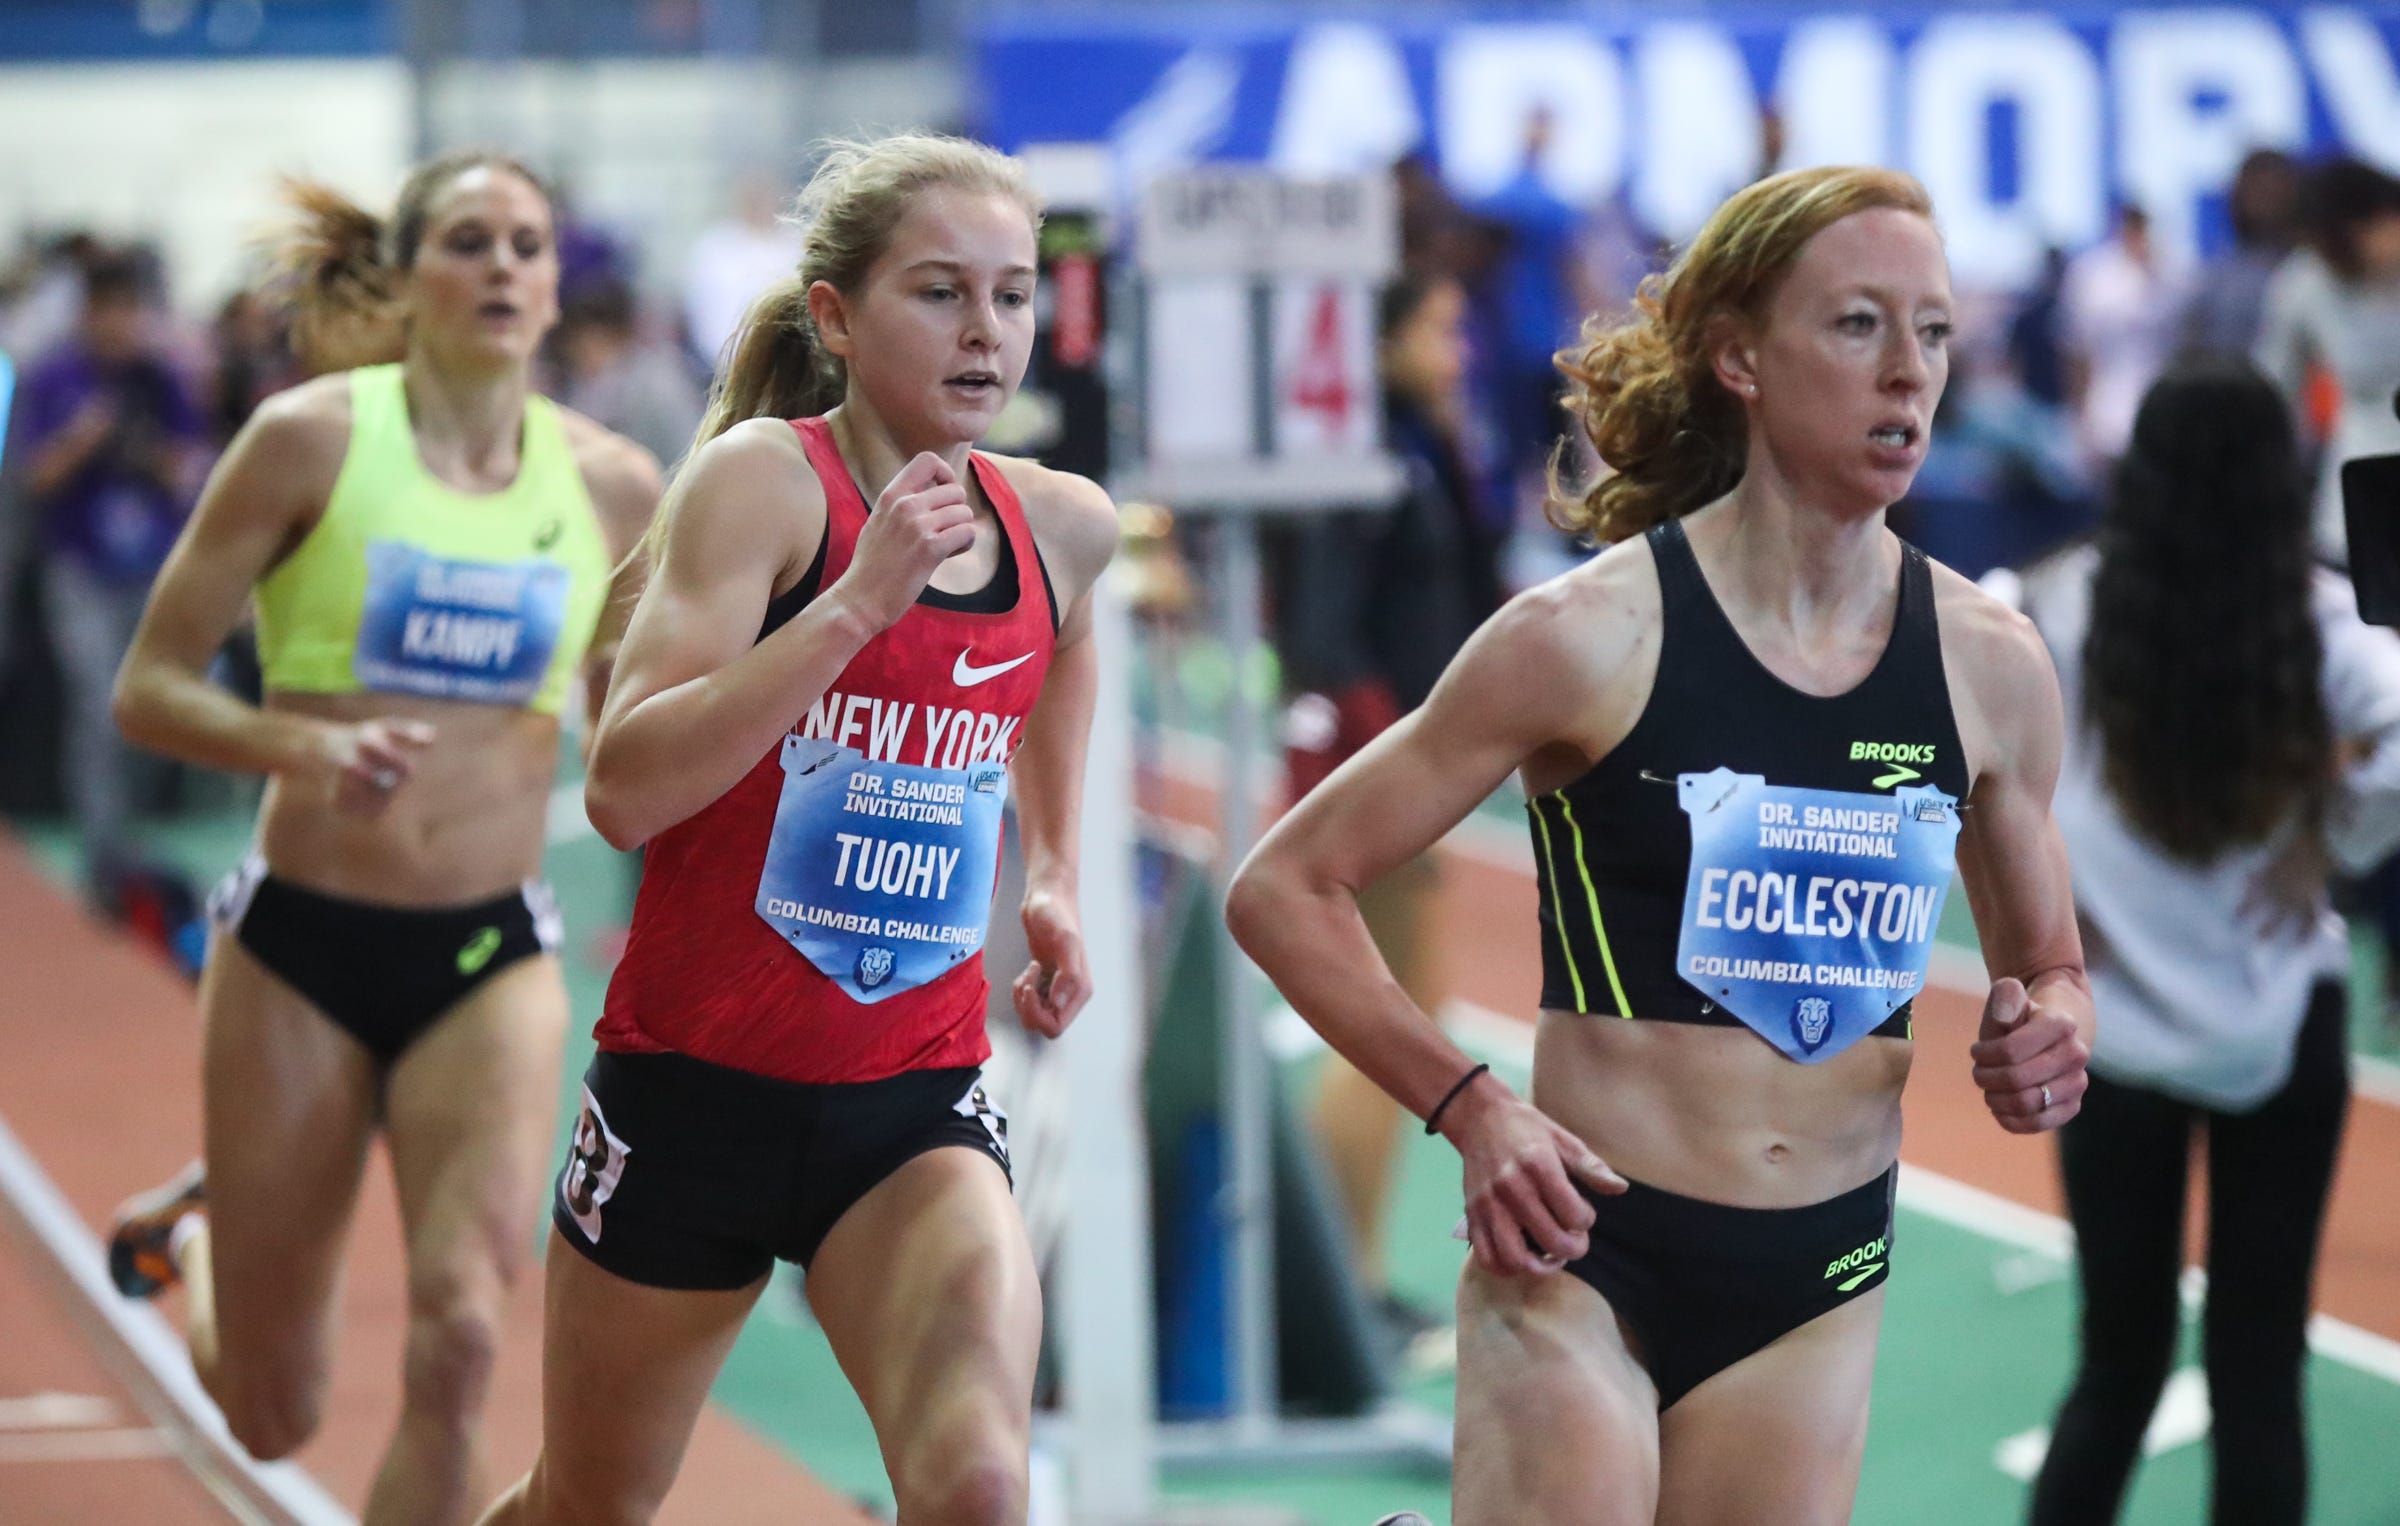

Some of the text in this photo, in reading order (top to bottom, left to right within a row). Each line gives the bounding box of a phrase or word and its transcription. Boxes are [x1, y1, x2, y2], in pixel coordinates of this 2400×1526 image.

[1292, 278, 1350, 446] 4
[803, 692, 1020, 771] NEW YORK
[1850, 741, 1936, 763] BROOKS
[849, 772, 965, 804] DR. SANDER
[843, 793, 963, 826] INVITATIONAL
[1759, 802, 1899, 834] DR. SANDER
[1759, 827, 1897, 859] INVITATIONAL
[834, 832, 960, 900] TUOHY
[766, 897, 979, 945] COLUMBIA CHALLENGE
[1696, 868, 1937, 943] ECCLESTON
[1690, 956, 1918, 989] COLUMBIA CHALLENGE
[1824, 1236, 1887, 1279] BROOK
